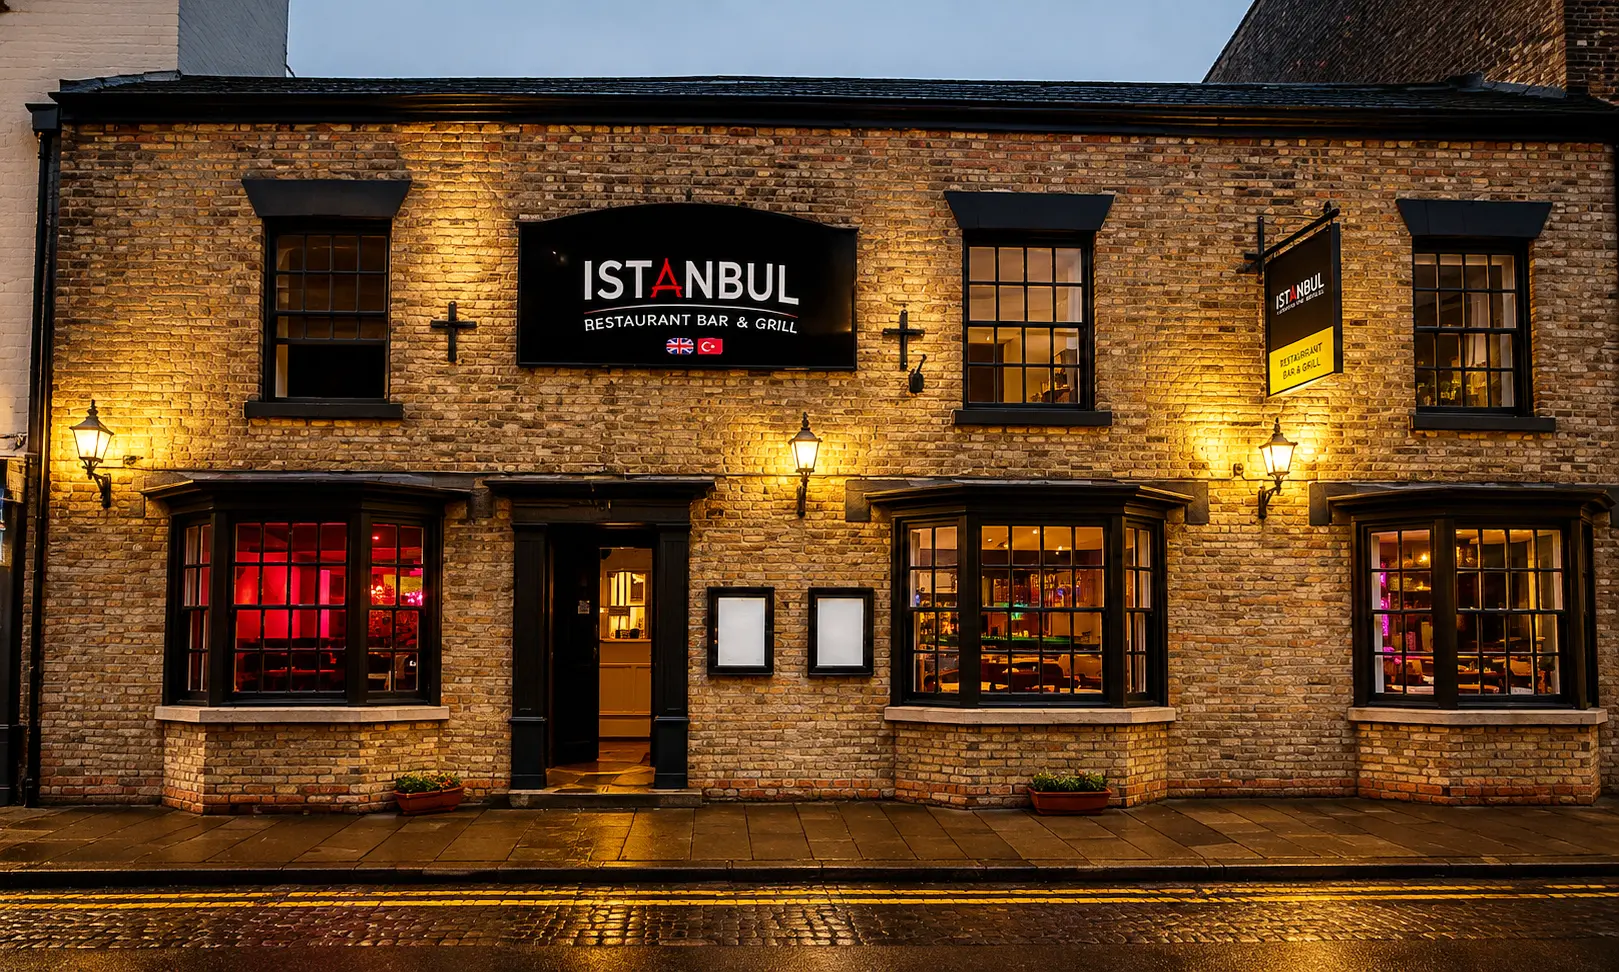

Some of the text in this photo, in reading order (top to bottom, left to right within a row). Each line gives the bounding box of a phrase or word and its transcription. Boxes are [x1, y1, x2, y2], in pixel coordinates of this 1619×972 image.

[584, 257, 799, 305] ISTANBUL
[1276, 272, 1325, 310] ISTANBUL
[584, 314, 797, 334] RESTAURANT BAR & GRILL
[1282, 367, 1296, 380] BAR
[1302, 357, 1321, 372] GRILL
